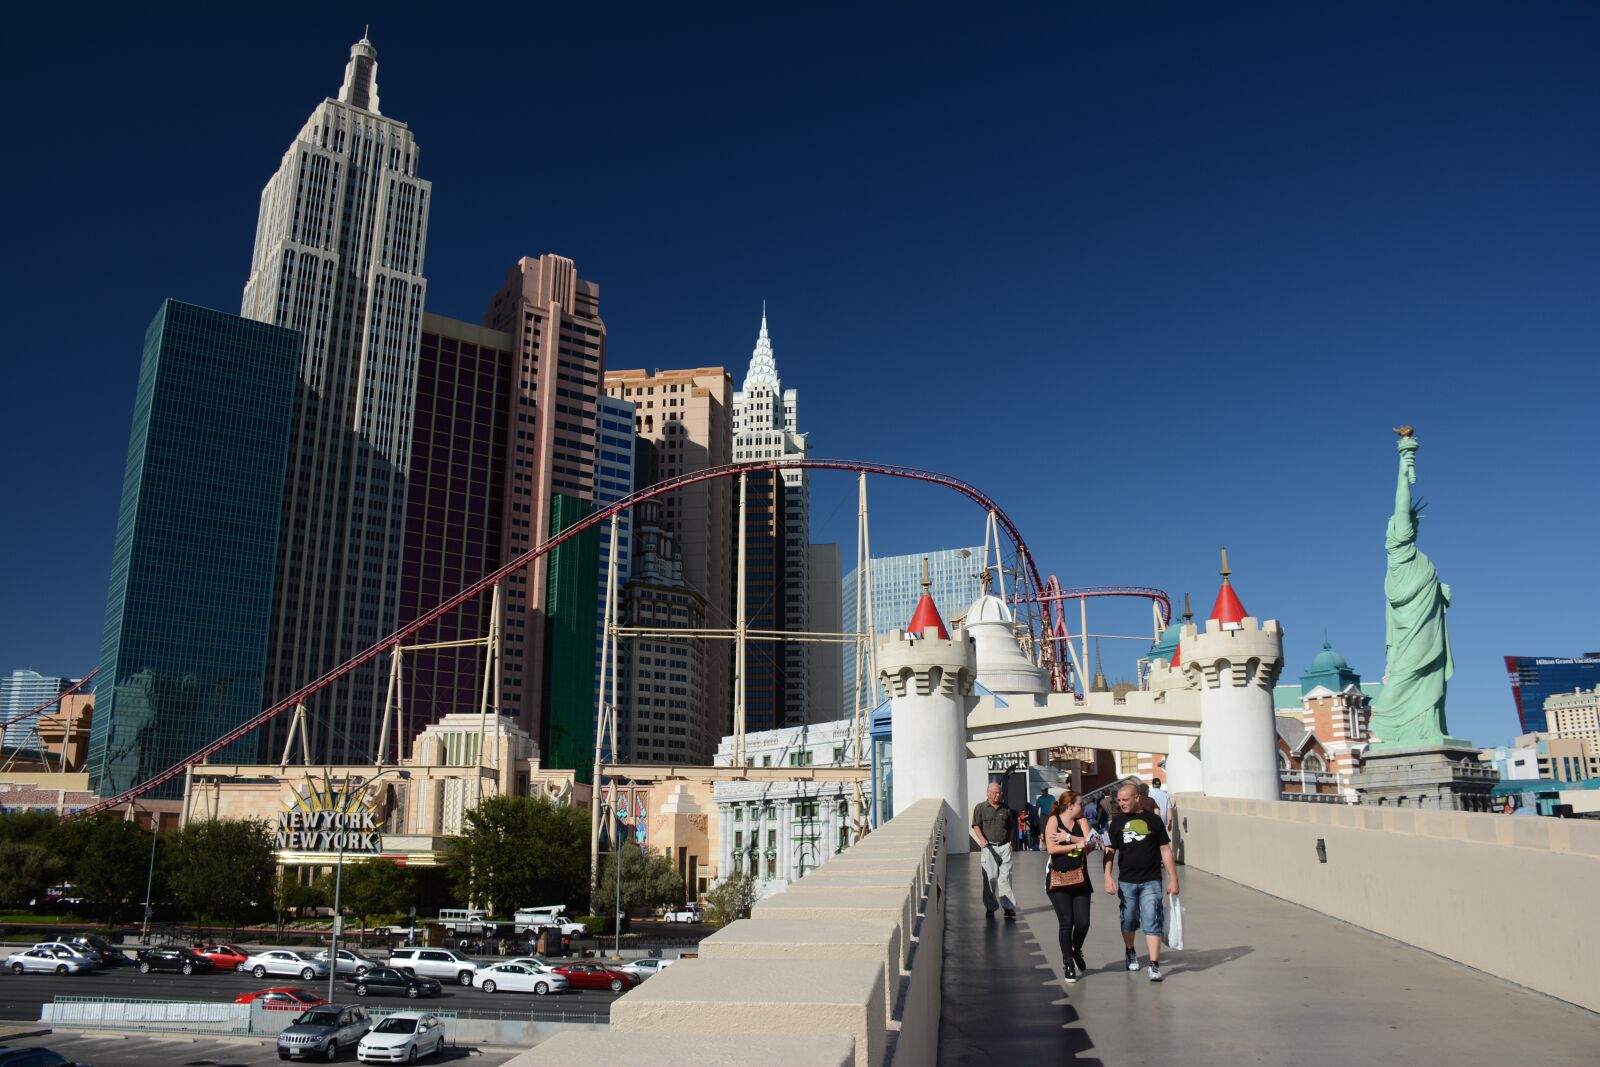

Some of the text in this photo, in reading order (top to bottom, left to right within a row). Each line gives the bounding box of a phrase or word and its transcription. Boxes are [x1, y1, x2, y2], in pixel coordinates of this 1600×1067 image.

[278, 812, 376, 828] NEW YORK
[275, 832, 375, 849] NEW YORK
